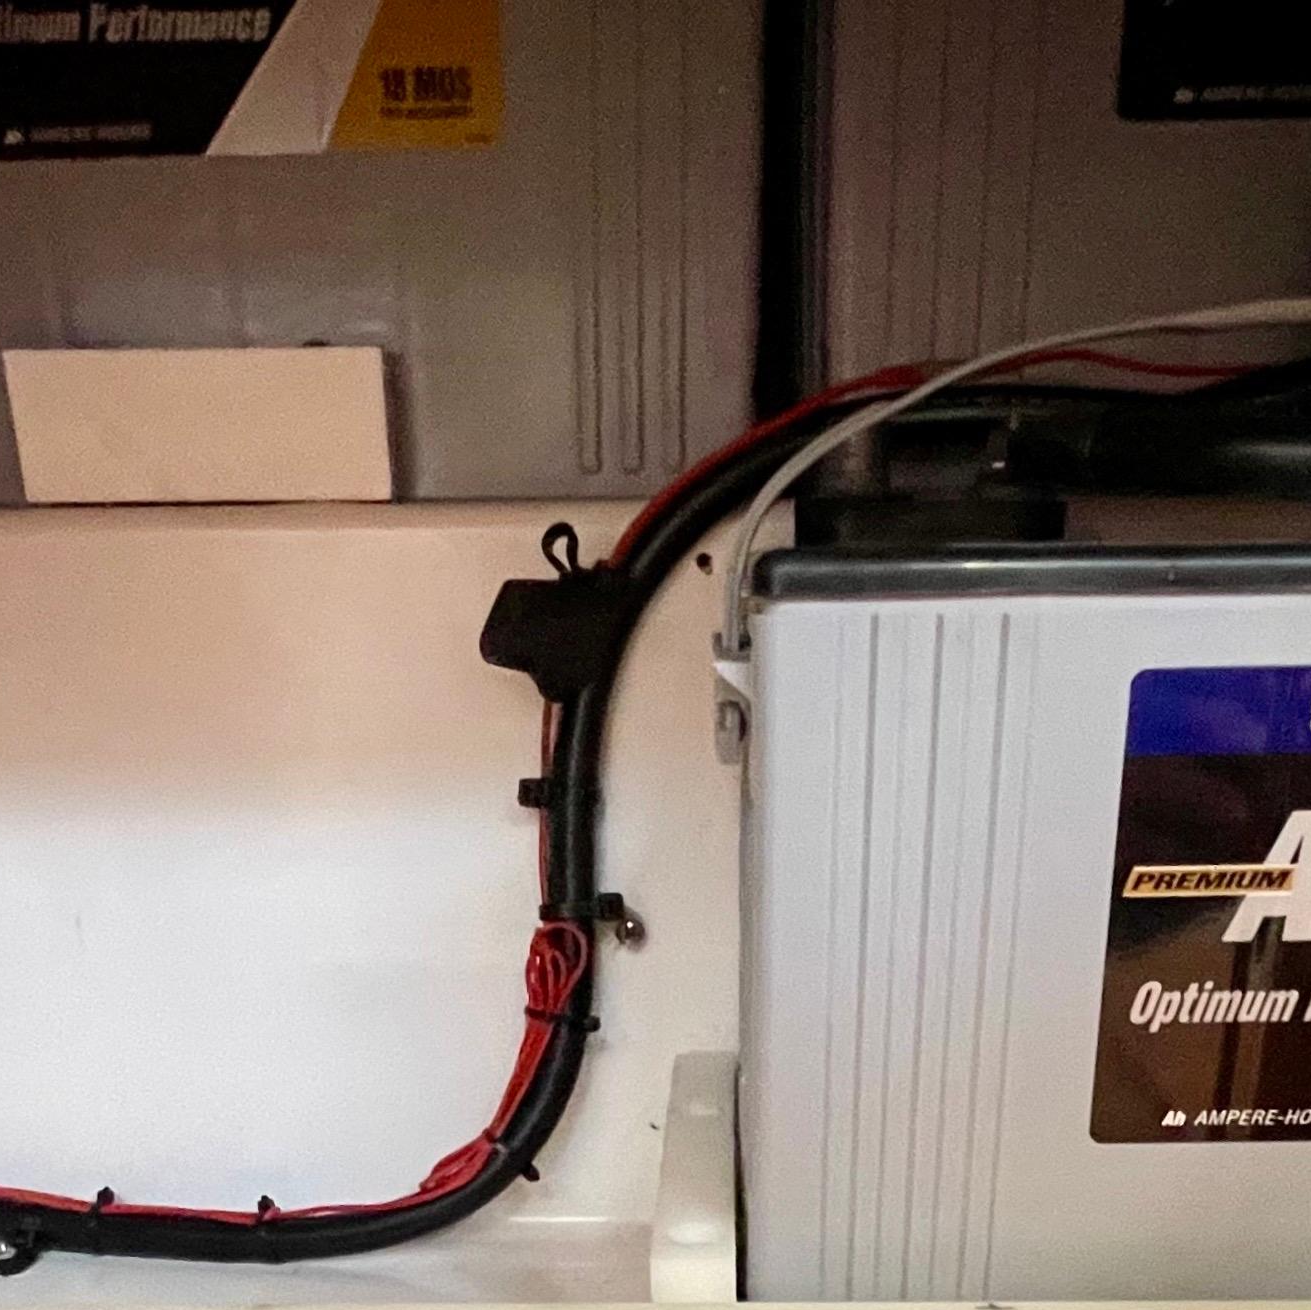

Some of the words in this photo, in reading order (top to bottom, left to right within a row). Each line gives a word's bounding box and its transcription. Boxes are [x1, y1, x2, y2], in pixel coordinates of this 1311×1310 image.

[89, 3, 272, 44] Performance
[1131, 869, 1294, 891] PREMIUM
[1129, 979, 1300, 1033] Optimum
